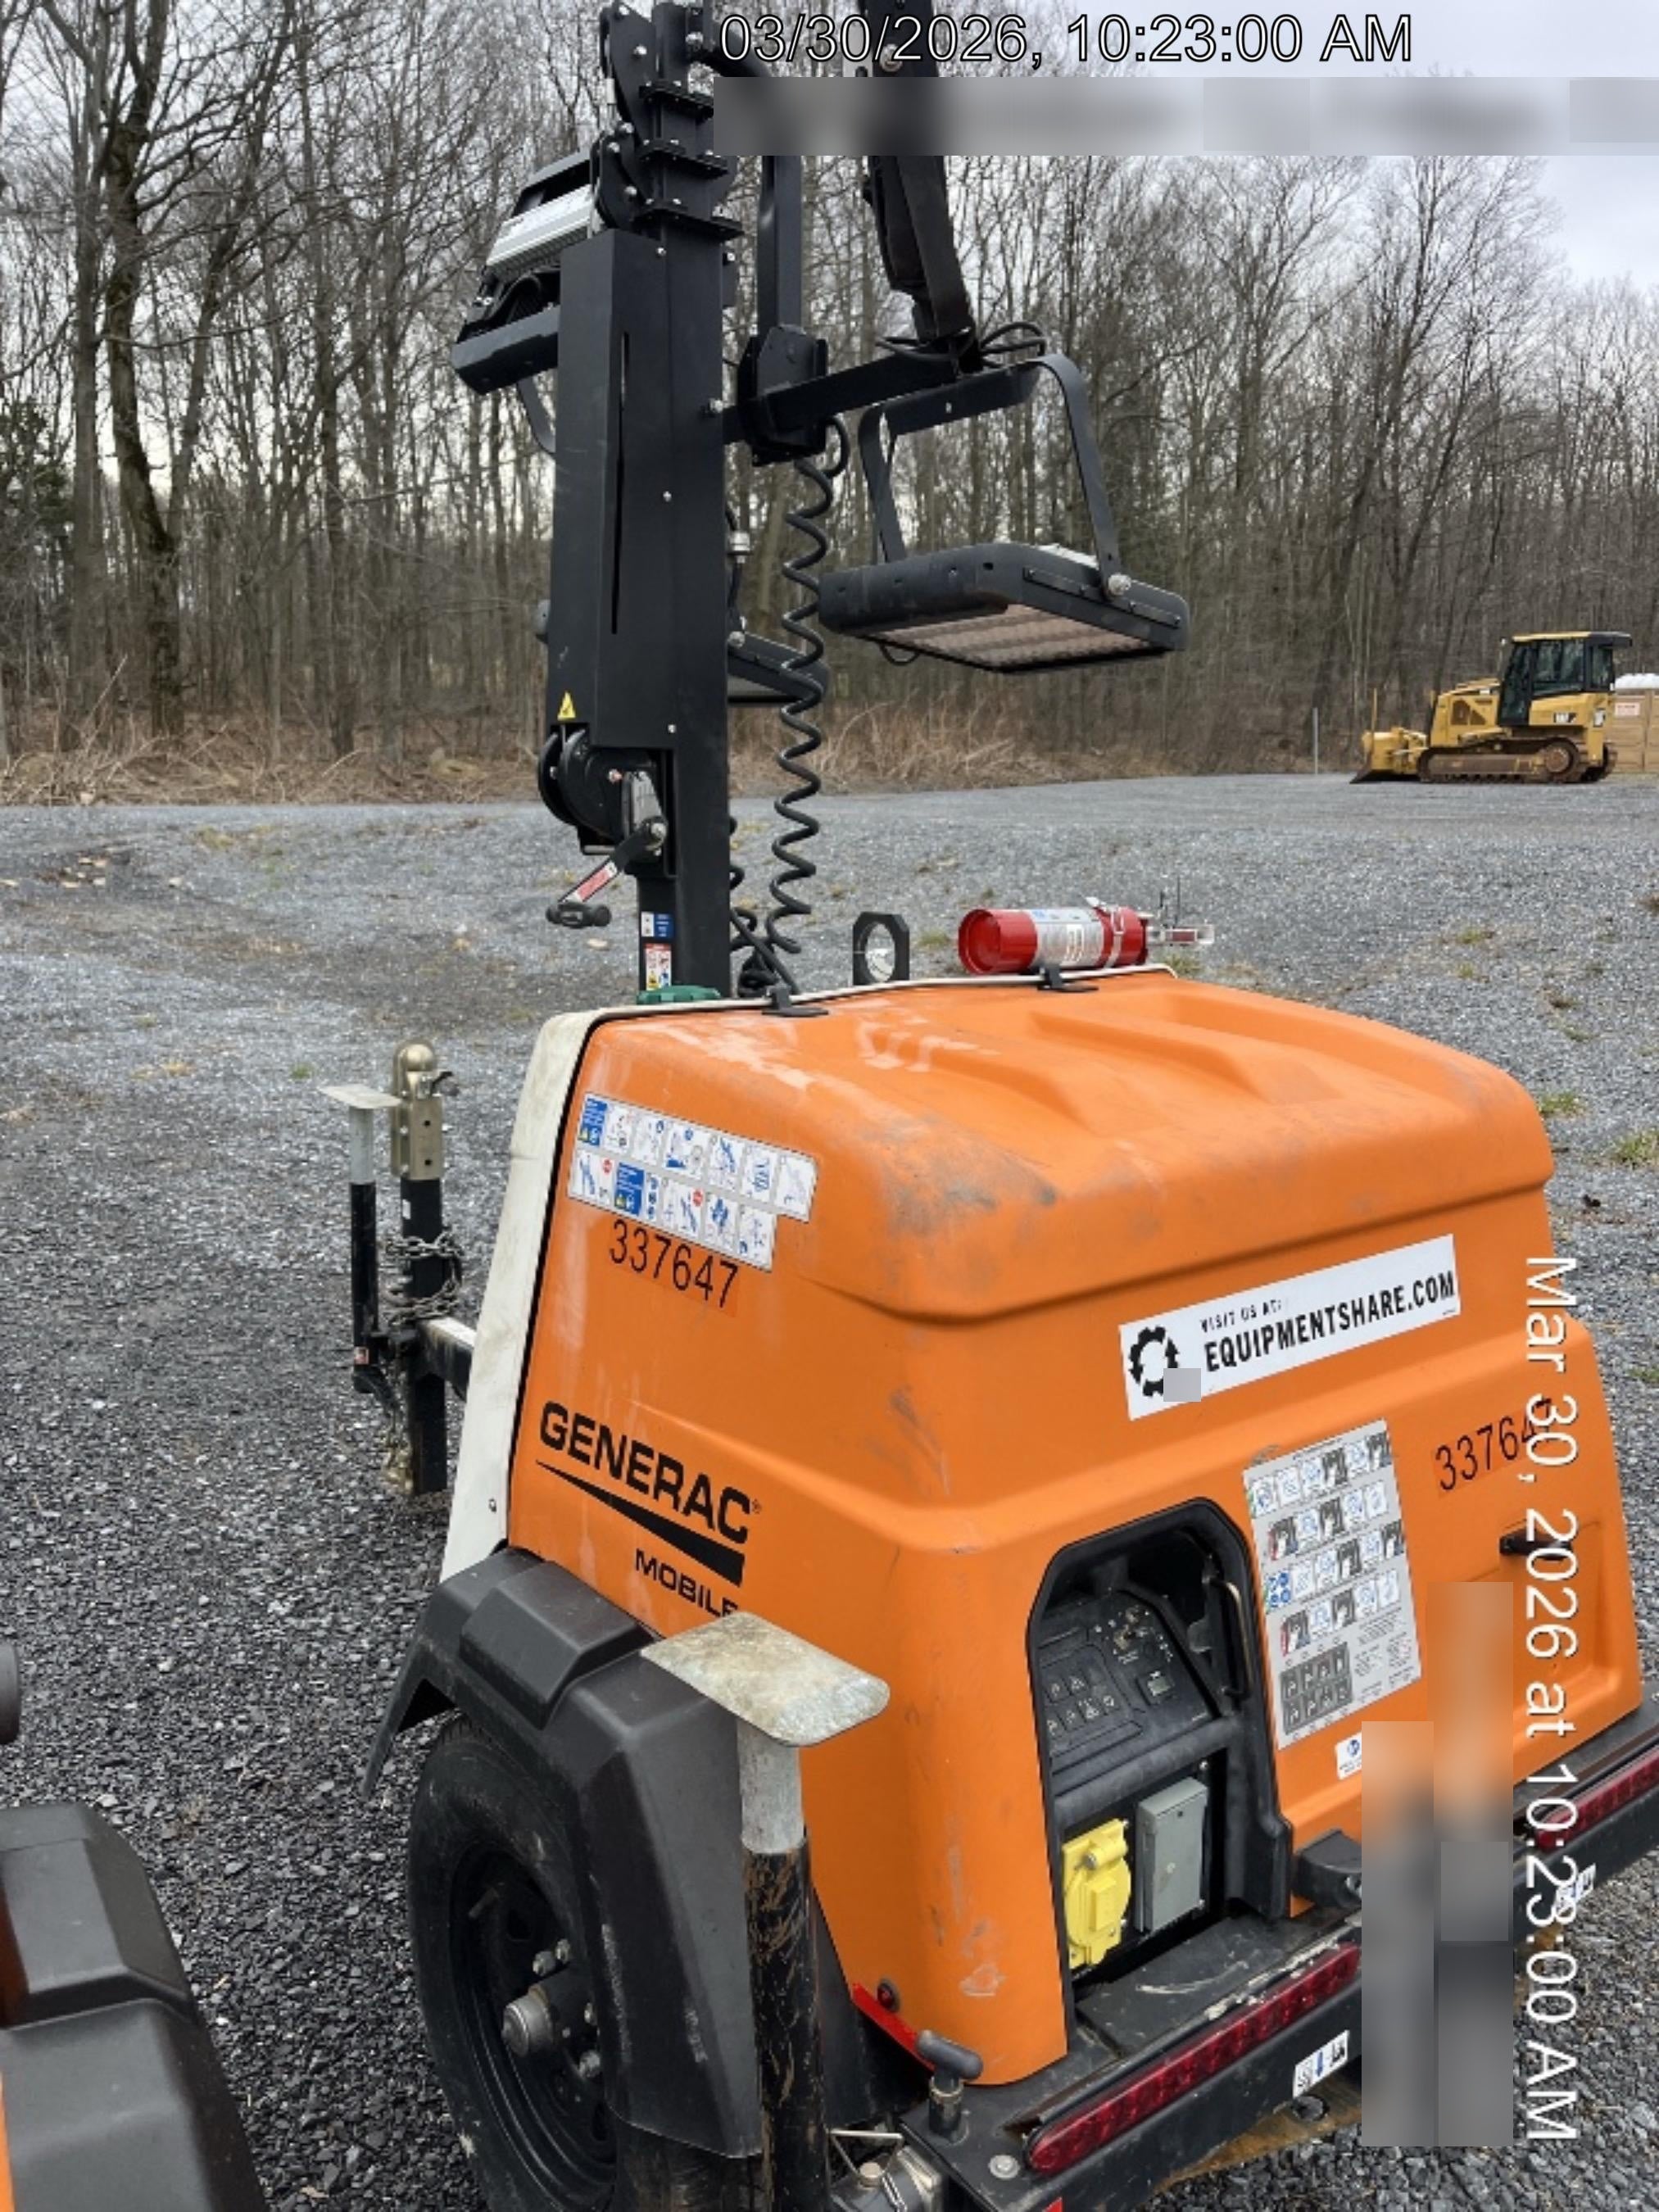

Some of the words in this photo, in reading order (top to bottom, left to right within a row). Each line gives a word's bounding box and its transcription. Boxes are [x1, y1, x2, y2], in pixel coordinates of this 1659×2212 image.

[609, 1218, 739, 1308] 337647
[1199, 1310, 1235, 1333] VISIT
[1240, 1304, 1257, 1322] US
[1203, 1269, 1456, 1373] EQUIPMENTSHARE.COM
